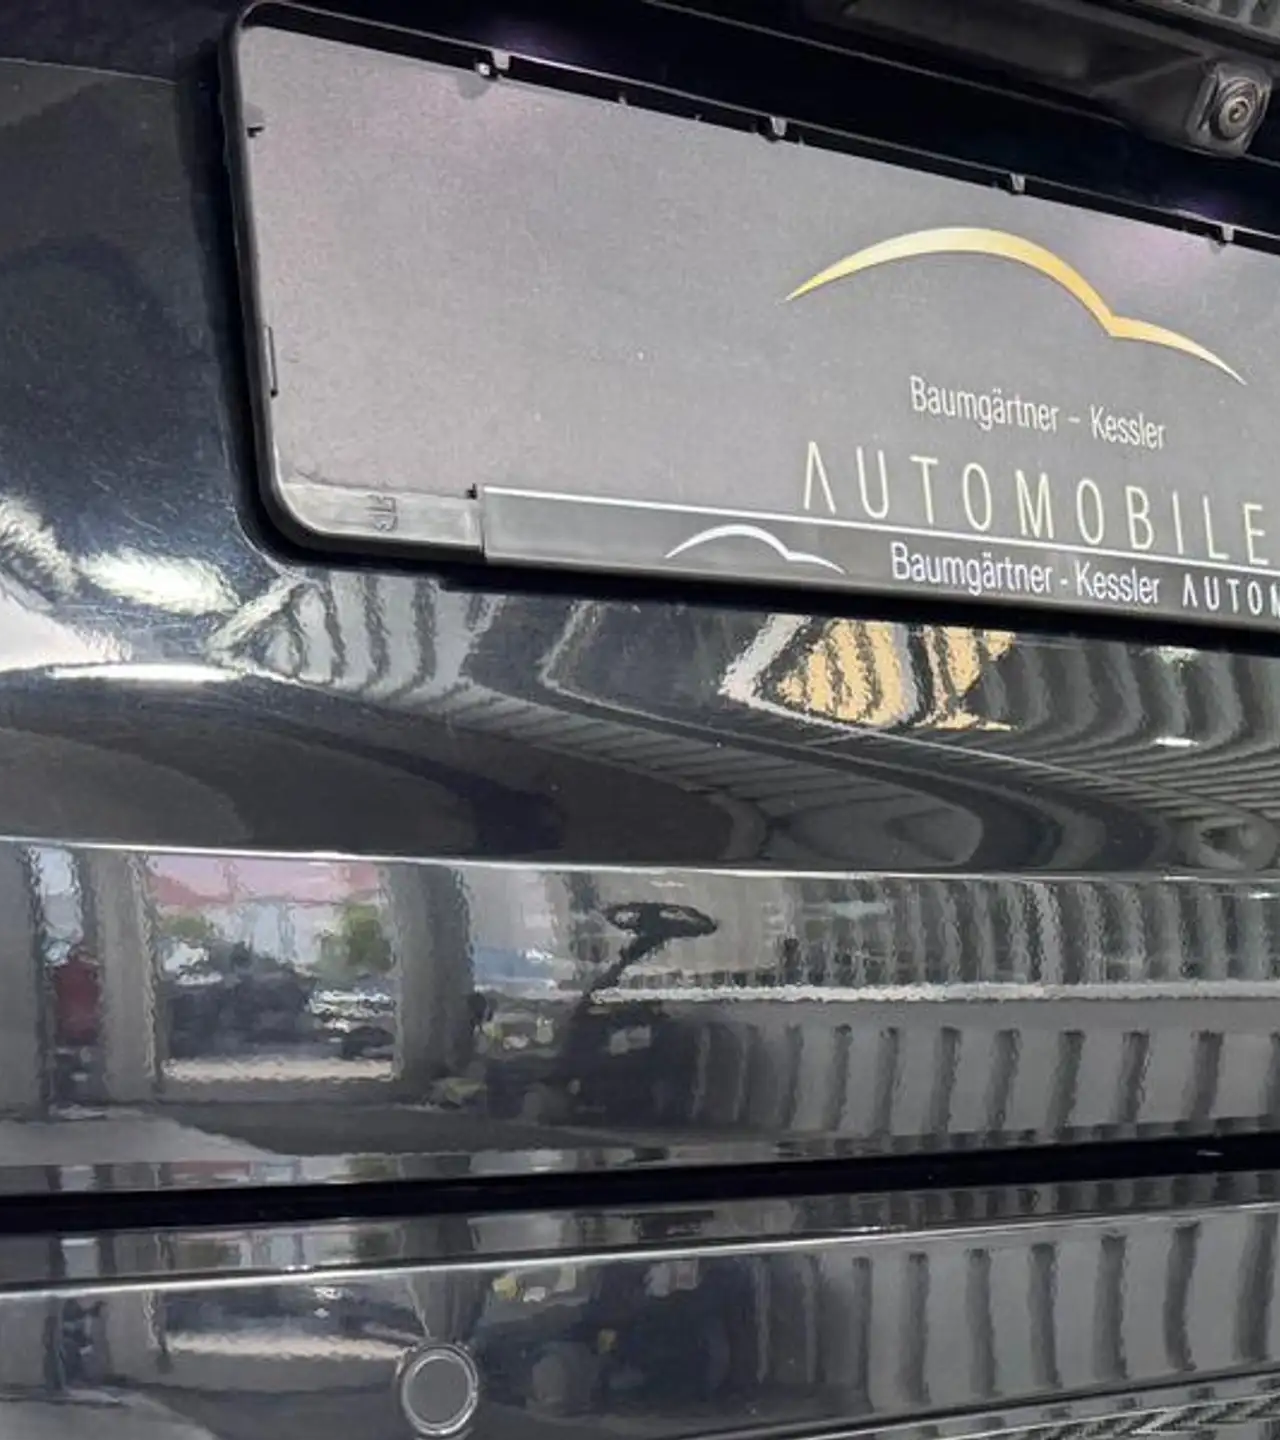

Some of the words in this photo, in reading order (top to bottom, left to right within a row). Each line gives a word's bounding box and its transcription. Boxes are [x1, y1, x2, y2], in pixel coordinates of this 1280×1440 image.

[909, 374, 1060, 432] Baumgärtner
[1089, 403, 1167, 450] Kessler
[803, 440, 1270, 566] AUTOMOBILE
[890, 541, 1054, 597] Baumgärtner
[1074, 559, 1161, 605] Kessler
